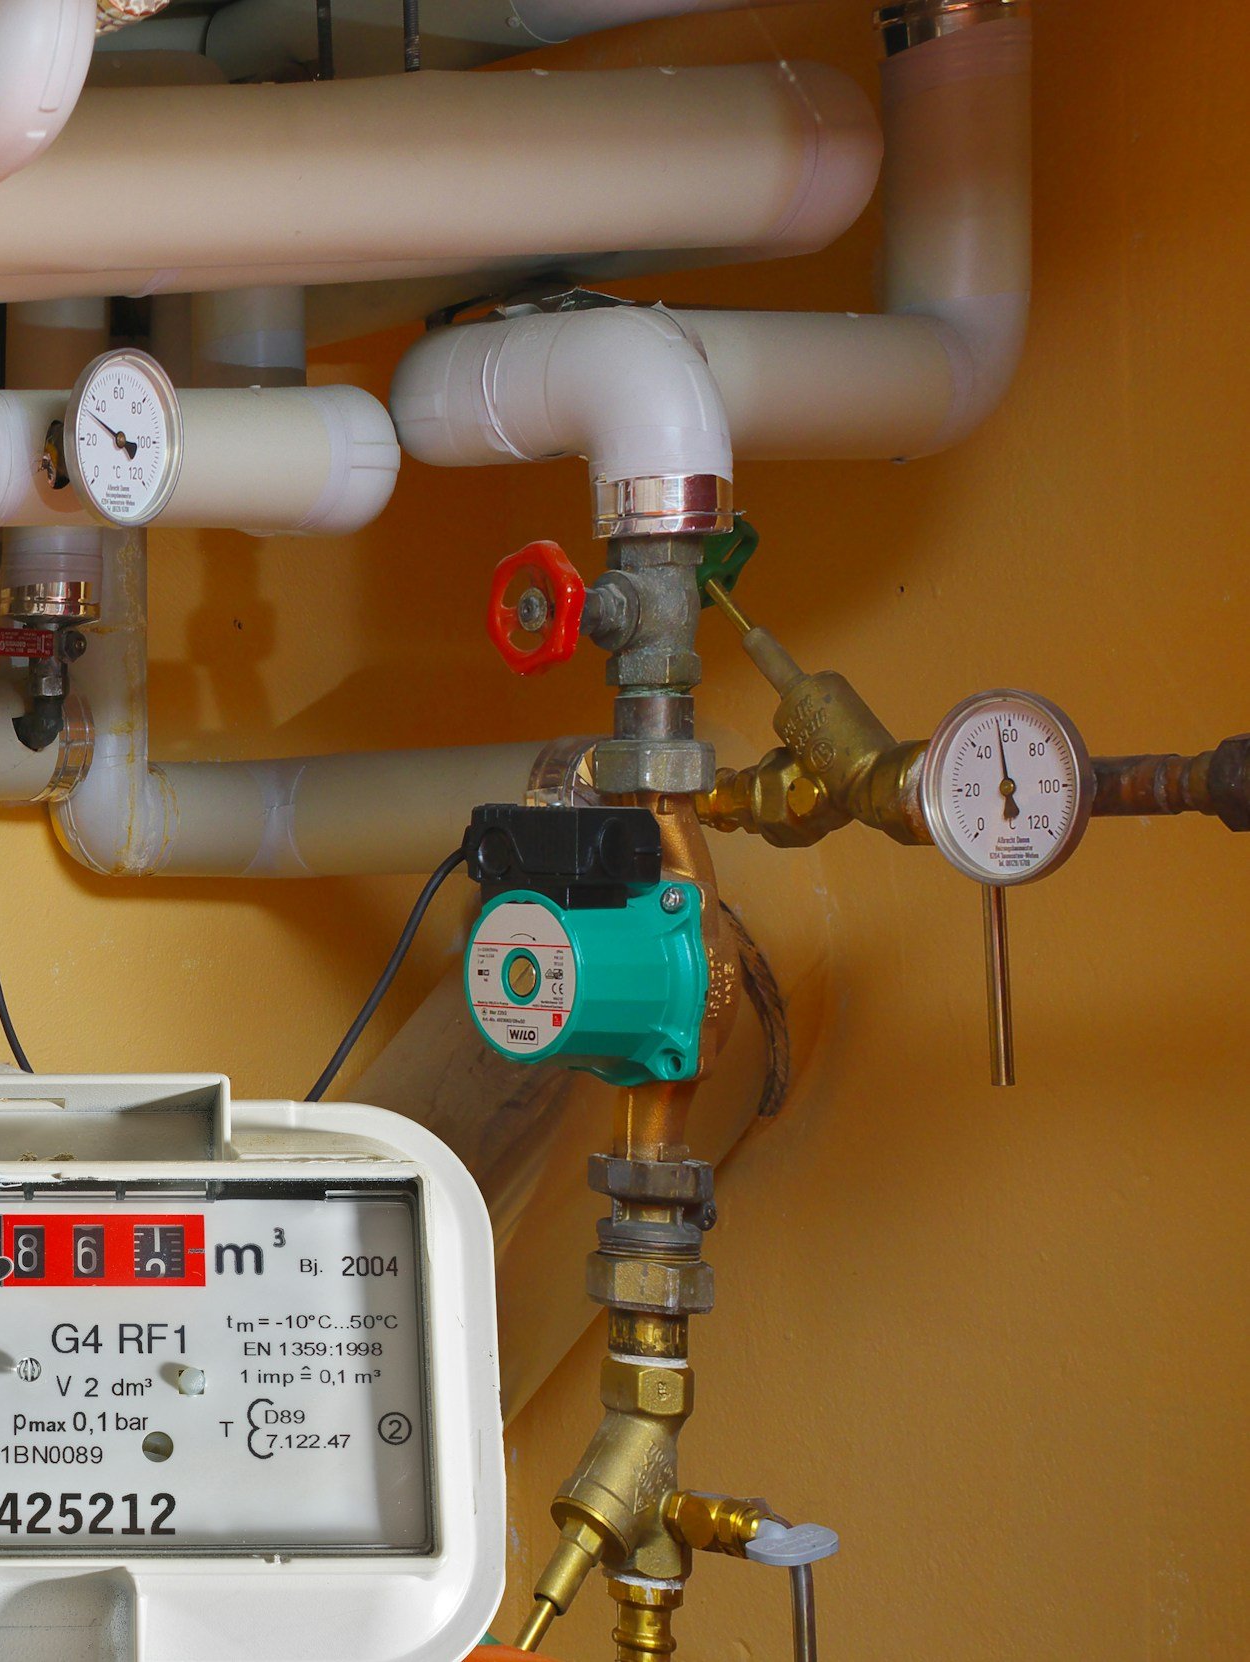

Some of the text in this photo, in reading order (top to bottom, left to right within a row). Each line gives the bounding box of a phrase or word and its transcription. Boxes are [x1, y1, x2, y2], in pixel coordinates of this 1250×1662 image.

[113, 386, 124, 400] 60
[95, 400, 106, 413] 40
[132, 402, 142, 414] 80
[86, 433, 97, 446] 20
[137, 436, 150, 448] 100
[94, 465, 100, 478] 0
[112, 466, 121, 478] °C
[128, 467, 143, 480] 120
[1002, 728, 1018, 742] 60
[976, 746, 992, 760] 40
[1029, 742, 1045, 756] 80
[965, 783, 980, 798] 20
[1038, 779, 1060, 794] 100
[977, 817, 984, 830] 0
[1028, 815, 1049, 830] 120
[509, 1029, 536, 1041] WILO
[300, 1256, 399, 1277] Bj. 2004
[51, 1323, 186, 1354] G4 RF1
[243, 1342, 383, 1356] EN 1359:1998
[240, 1369, 248, 1383] 1
[257, 1369, 294, 1387] imp
[319, 1369, 346, 1386] 0,1
[354, 1369, 381, 1383] m³
[56, 1375, 153, 1397] V 2 dm³
[13, 1411, 149, 1435] pmax 0,1 bar
[265, 1410, 305, 1424] D89
[219, 1421, 234, 1437] T
[266, 1434, 351, 1449] 7.122.47
